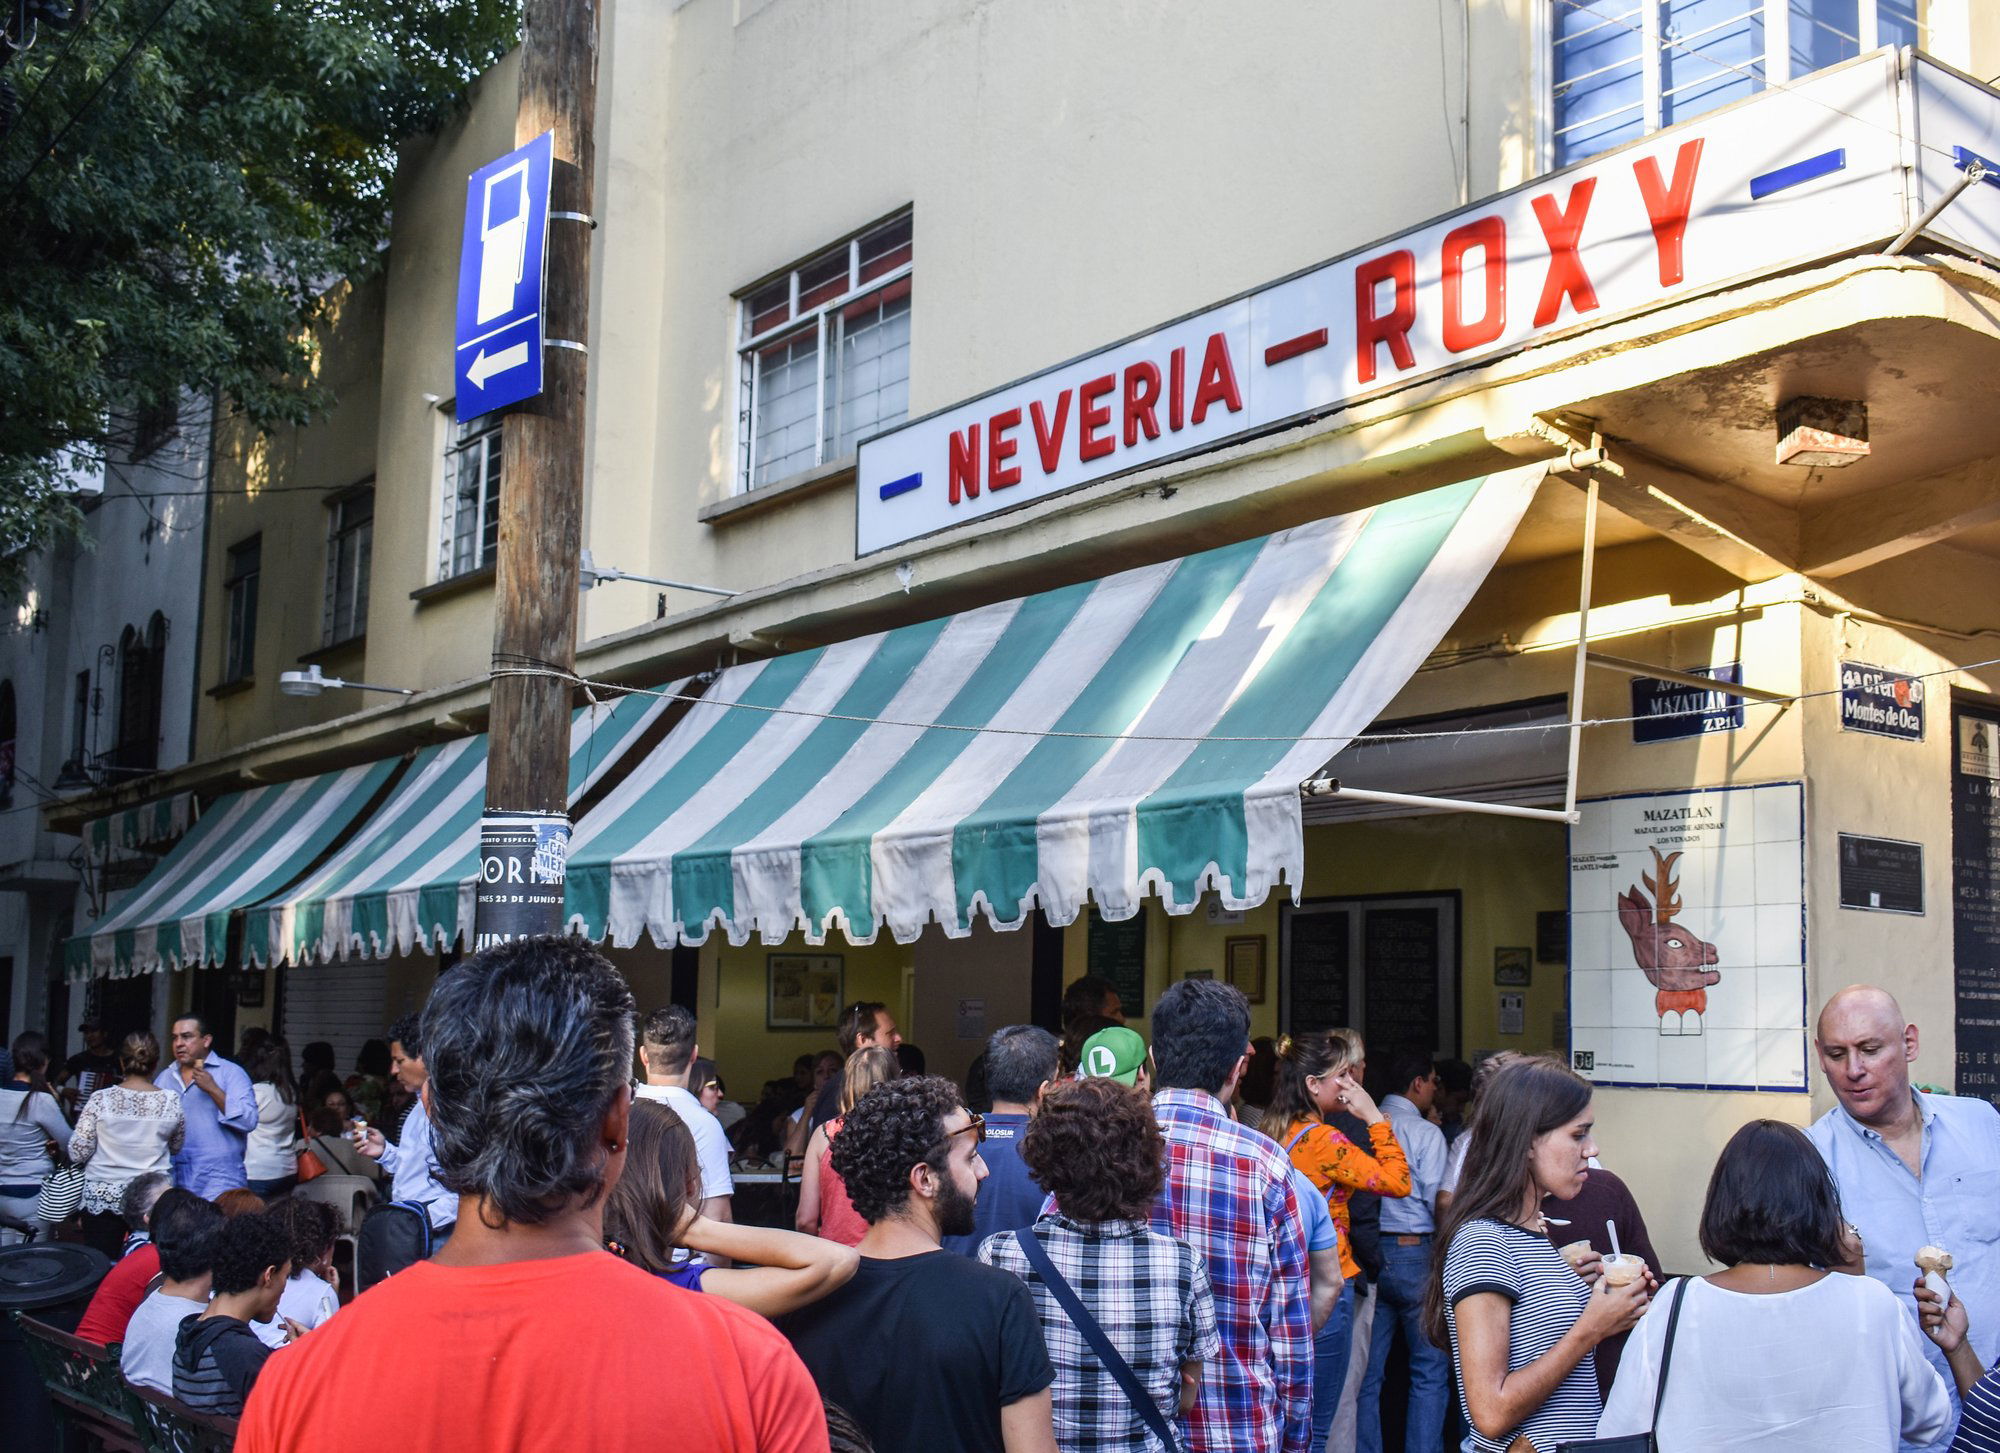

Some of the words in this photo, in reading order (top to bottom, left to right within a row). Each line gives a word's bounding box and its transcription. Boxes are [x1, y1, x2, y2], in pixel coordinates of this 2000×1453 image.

[949, 333, 1241, 503] NEVERIA
[1356, 138, 1705, 385] ROXY
[1651, 691, 1727, 715] MAZATLAN
[1845, 697, 1885, 724] Montes
[1886, 706, 1899, 726] de
[1899, 708, 1920, 731] Oca
[1644, 806, 1713, 821] MAZATLAN
[495, 894, 508, 903] 23
[511, 895, 524, 903] DE
[527, 896, 556, 904] JUNIO
[1093, 1050, 1111, 1073] L
